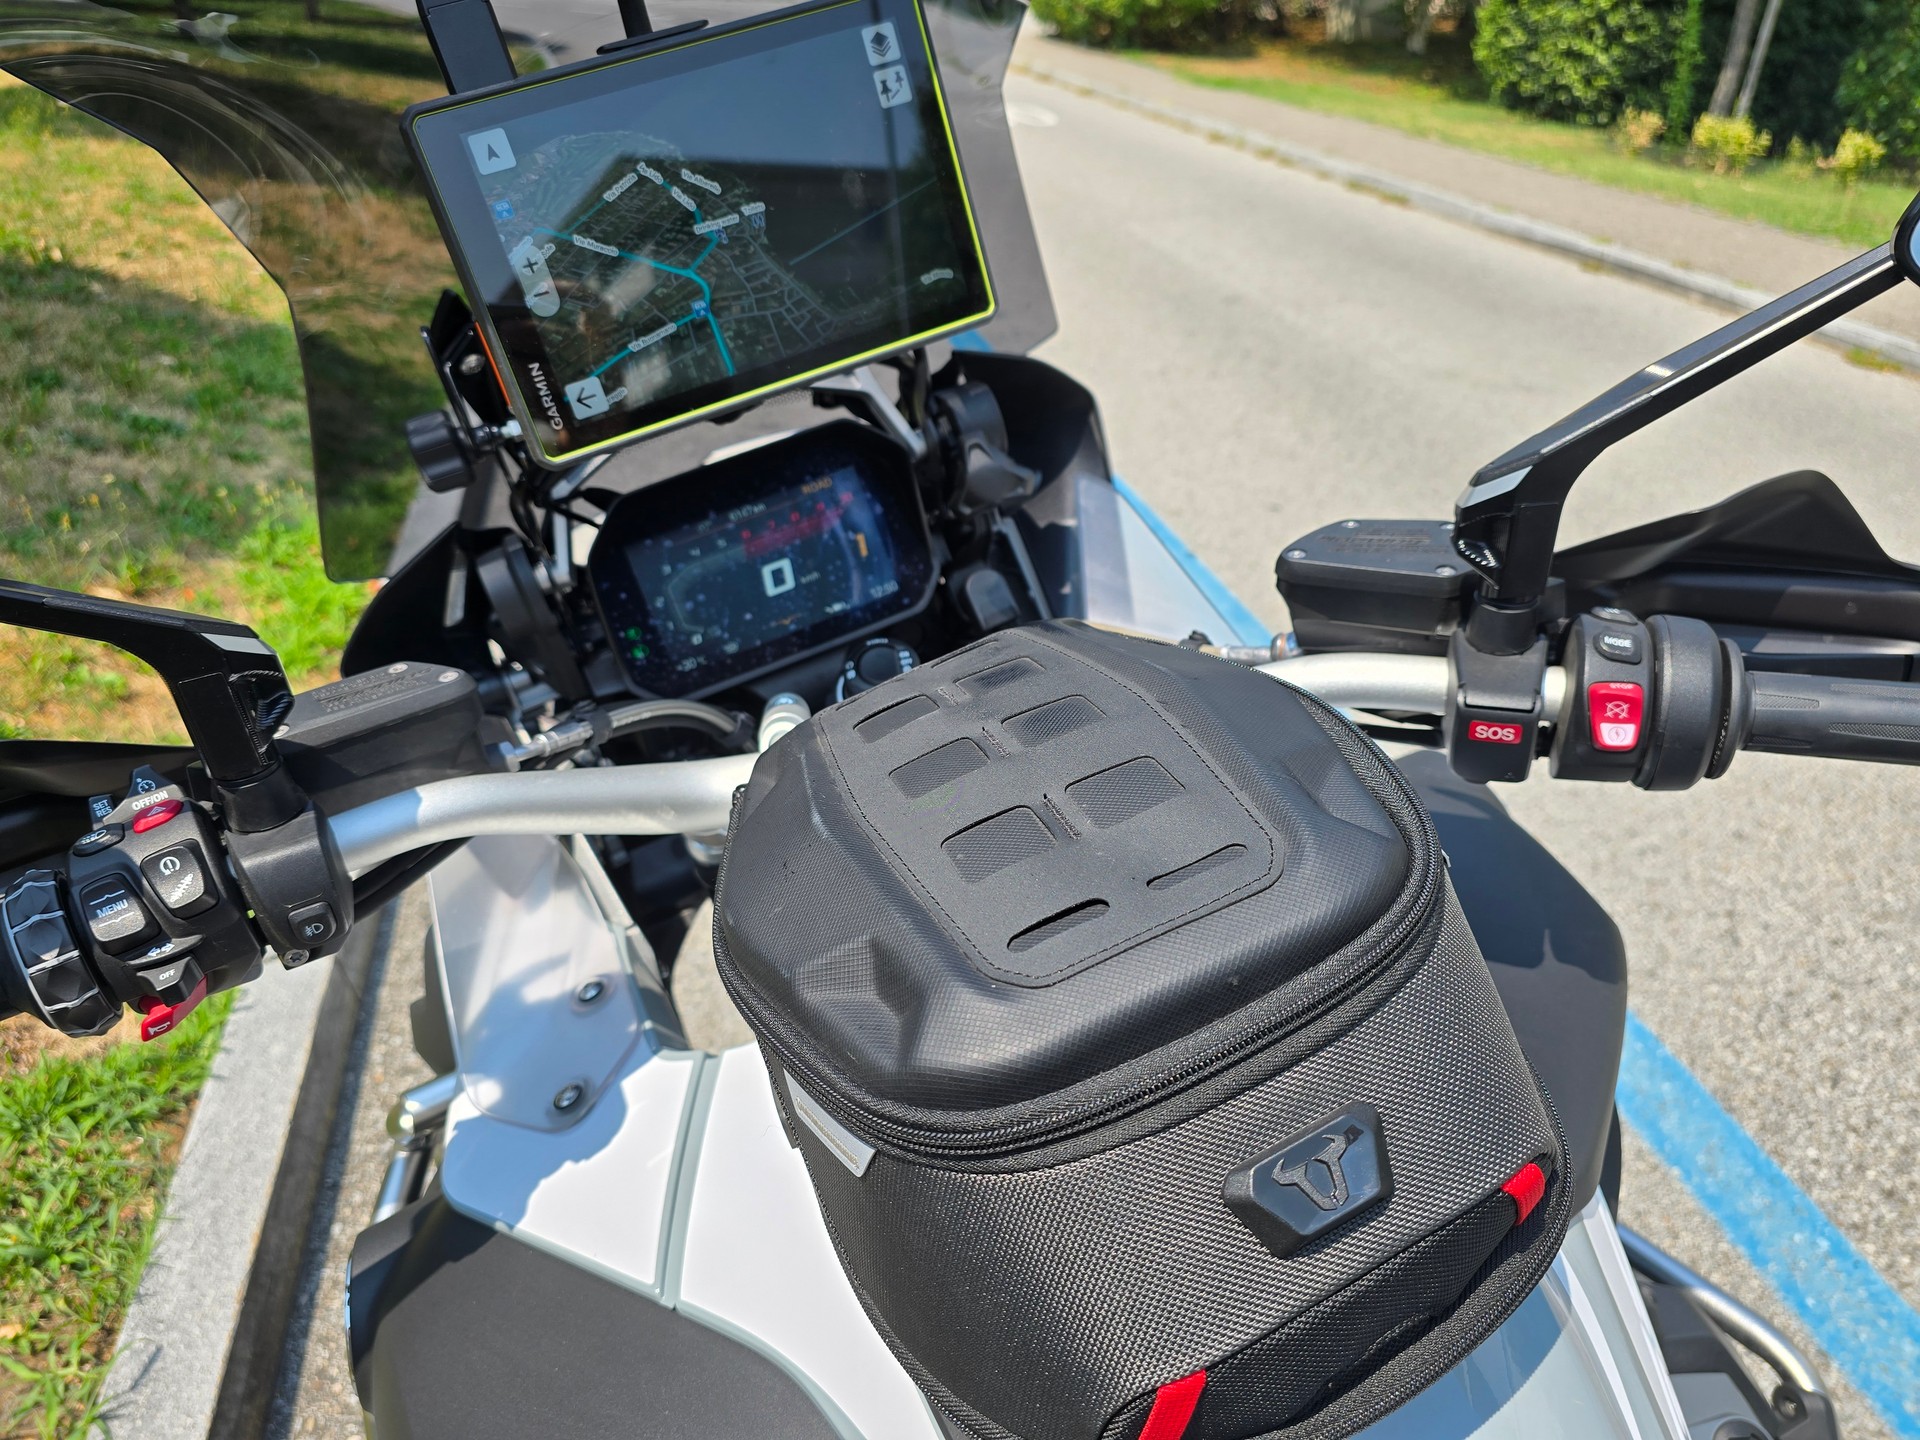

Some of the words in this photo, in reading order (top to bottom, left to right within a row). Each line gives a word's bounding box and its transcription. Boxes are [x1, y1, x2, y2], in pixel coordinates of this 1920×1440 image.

[528, 362, 564, 430] GARMIN
[801, 476, 833, 495] ROAD
[761, 557, 796, 598] 0
[1604, 635, 1633, 648] MODE
[1474, 725, 1516, 742] SOS
[93, 799, 109, 811] SET
[131, 790, 169, 811] OFF/ON
[95, 806, 113, 818] RES
[96, 899, 129, 918] MENU
[159, 968, 176, 981] OFF
